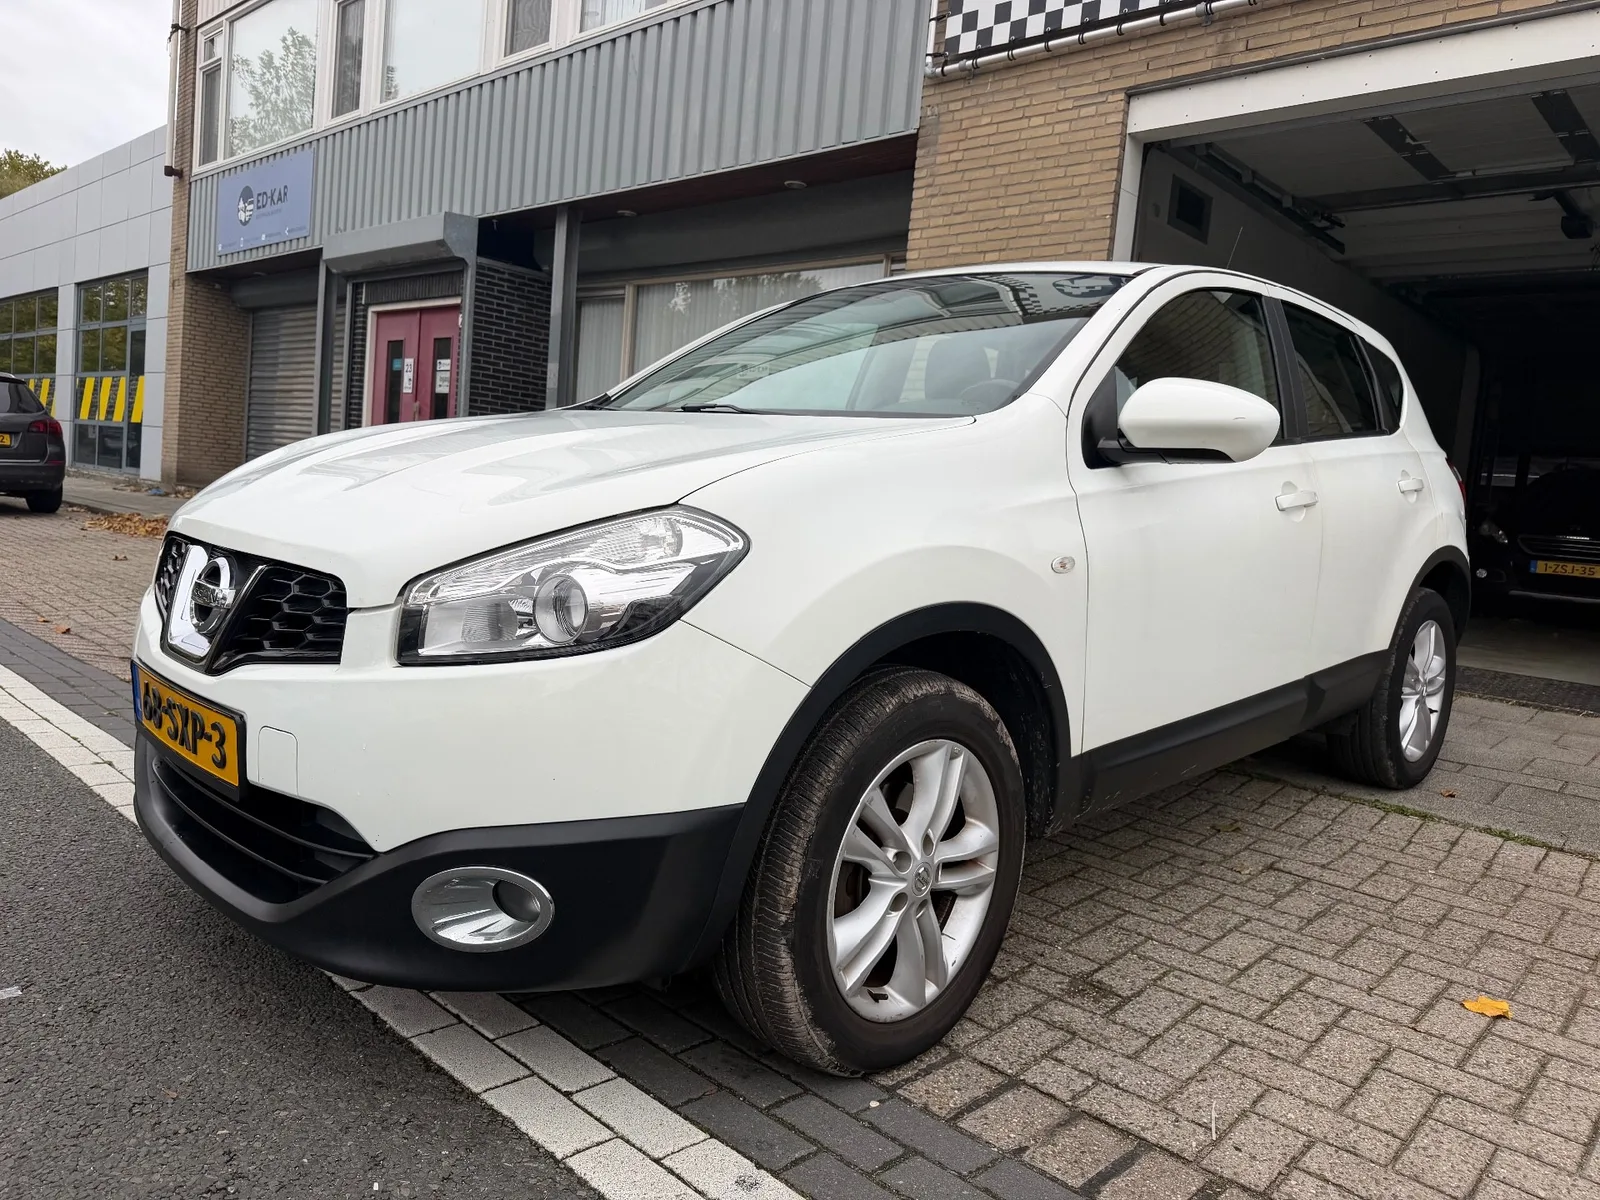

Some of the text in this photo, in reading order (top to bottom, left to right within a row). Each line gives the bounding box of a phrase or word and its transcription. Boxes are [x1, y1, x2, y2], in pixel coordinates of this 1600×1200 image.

[256, 185, 288, 210] ED-KAR
[1543, 562, 1596, 576] 1-ZSJ-35
[143, 680, 227, 769] 68-SXP-3
